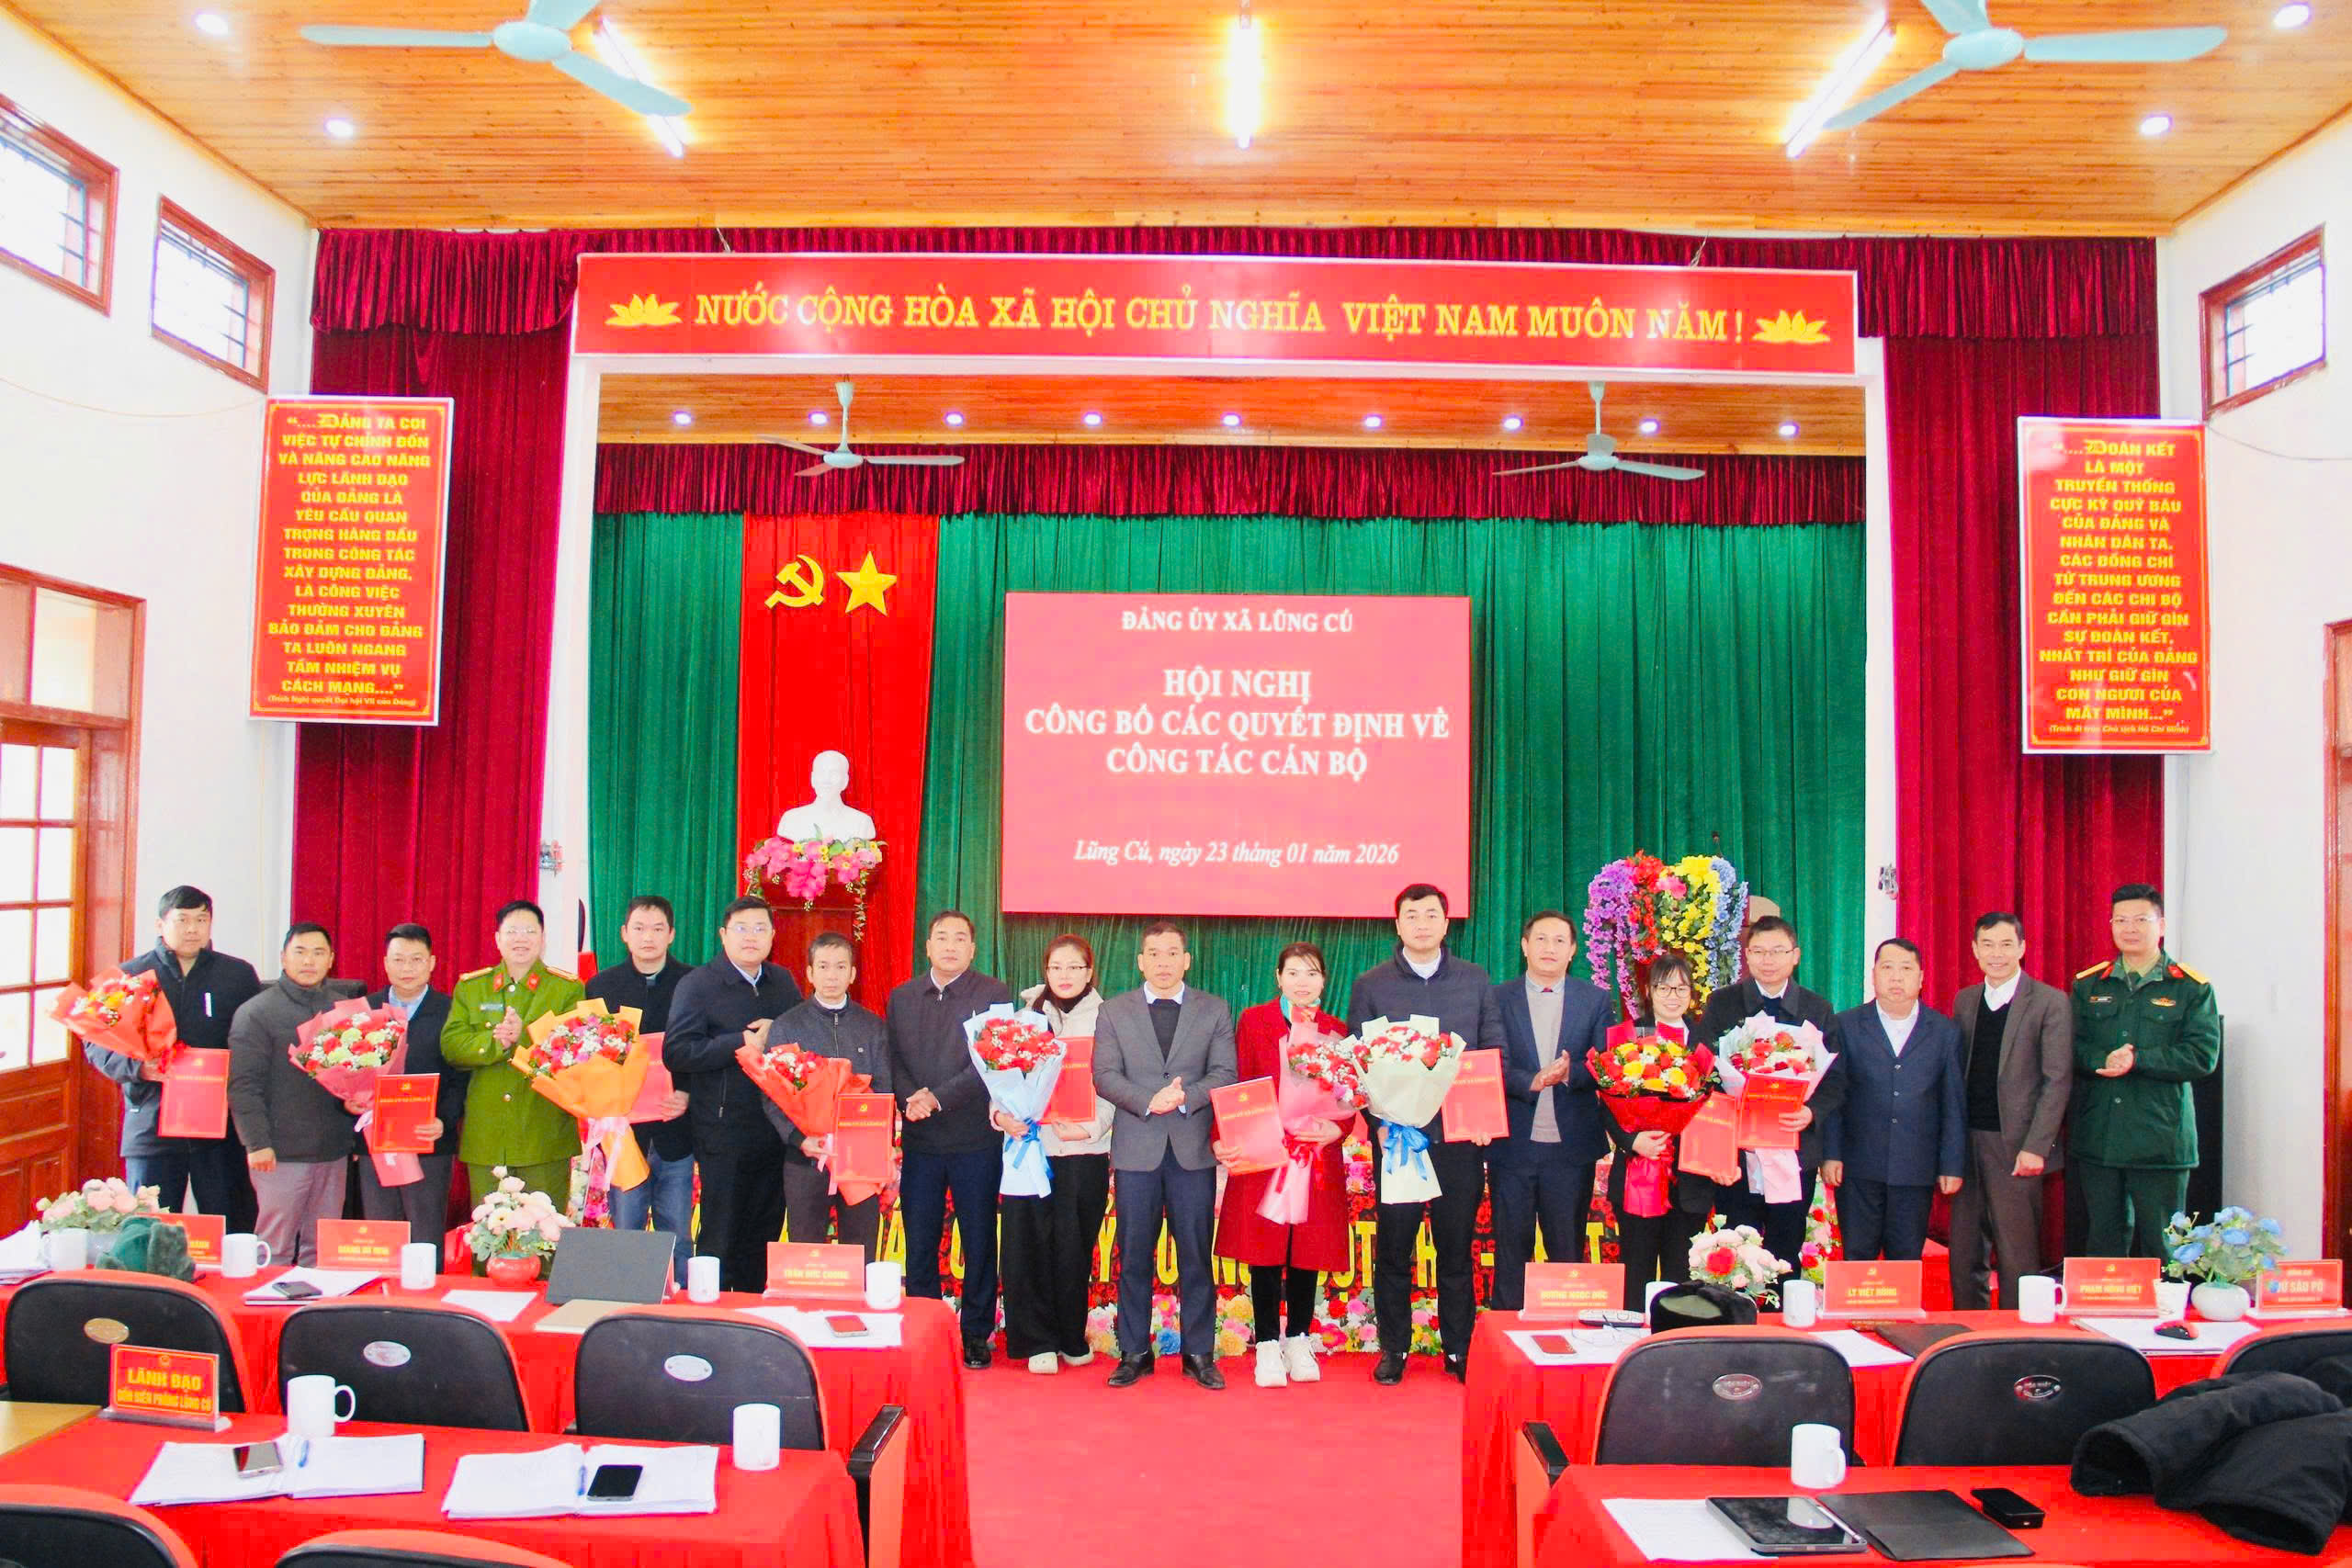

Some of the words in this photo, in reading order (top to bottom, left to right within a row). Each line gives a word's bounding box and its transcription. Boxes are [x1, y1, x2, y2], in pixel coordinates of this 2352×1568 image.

[695, 283, 787, 325] NƯỚC
[797, 287, 893, 333] CỘNG
[903, 286, 978, 327] HÒA
[989, 288, 1040, 328] XÃ
[1051, 288, 1115, 336] HỘI
[1126, 286, 1196, 329] CHỦ
[1209, 291, 1324, 333] NGHĨA
[1342, 296, 1425, 341] VIỆT
[1435, 304, 1518, 337] NAM
[1528, 299, 1634, 338] MUÔN
[377, 414, 395, 430] TA
[400, 417, 425, 430] COI
[282, 433, 317, 448] VIỆC
[321, 434, 343, 449] TỰ
[2146, 441, 2176, 456] KẾT
[279, 451, 299, 465] VÀ
[302, 452, 346, 466] NÂNG
[350, 451, 382, 466] CAO
[2086, 459, 2105, 473] LÀ
[2109, 460, 2143, 476] MỘT
[298, 472, 327, 488] LỰC
[332, 471, 372, 485] LÃNH
[377, 474, 408, 488] ĐẠO
[2055, 478, 2118, 492] TRUYỀN
[2122, 478, 2175, 494] THỐNG
[301, 487, 332, 502] CỦA
[336, 488, 379, 503] ĐẢNG
[384, 487, 402, 504] LÀ
[2050, 497, 2082, 513] CỰC
[2087, 497, 2109, 511] KỲ
[2149, 499, 2181, 513] BÁU
[296, 507, 324, 522] YÊU
[329, 507, 359, 522] CẦU
[364, 511, 407, 524] QUAN
[2062, 513, 2095, 529] CỦA
[2099, 513, 2144, 530] ĐẢNG
[2149, 516, 2170, 531] VÀ
[284, 528, 334, 542] TRỌNG
[339, 527, 380, 541] HÀNG
[386, 527, 417, 542] ĐẦU
[2060, 535, 2106, 548] NHÂN
[2110, 535, 2144, 552] DÂN
[283, 547, 334, 560] TRONG
[338, 547, 381, 560] CÔNG
[385, 547, 415, 561] TÁC
[2060, 553, 2093, 568] CÁC
[2098, 552, 2143, 568] ĐỒNG
[2146, 555, 2174, 569] CHÍ
[284, 564, 314, 579] XÂY
[318, 566, 361, 581] DỰNG
[2054, 570, 2076, 586] TỪ
[2078, 573, 2132, 586] TRUNG
[2137, 574, 2181, 588] ƯƠNG
[295, 583, 314, 598] LÀ
[318, 583, 361, 598] CÔNG
[365, 584, 400, 601] VIỆC
[2053, 590, 2086, 609] ĐẾN
[2091, 591, 2124, 609] CÁC
[2129, 593, 2156, 606] CHI
[2161, 592, 2182, 608] BỘ
[354, 604, 405, 618] XUYÊN
[1122, 606, 1182, 630] ĐẢNG
[1223, 608, 1252, 631] XÃ
[1259, 609, 1317, 632] LŨNG
[1324, 608, 1352, 632] CÚ
[2086, 608, 2124, 625] PHẢI
[2129, 611, 2158, 626] GIỮ
[2161, 612, 2188, 626] GÌN
[268, 620, 300, 635] BẢO
[304, 620, 339, 636] ĐẢM
[345, 625, 376, 637] CHO
[379, 621, 423, 637] ĐẢNG
[2064, 629, 2087, 645] SỰ
[2090, 628, 2135, 643] ĐOÀN
[282, 641, 302, 658] TA
[306, 640, 347, 654] LUÔN
[352, 643, 406, 656] NGANG
[2039, 647, 2083, 662] NHẤT
[2086, 647, 2112, 662] TRÍ
[2117, 647, 2150, 663] CỦA
[2154, 647, 2198, 664] ĐẢNG
[324, 661, 376, 676] NHIỆM
[380, 662, 401, 678] VỤ
[2070, 669, 2104, 683] NHƯ
[2109, 667, 2138, 682] GIỮ
[2141, 668, 2169, 682] GÌN
[281, 679, 323, 697] CÁCH
[1163, 665, 1222, 705] HỘI
[1231, 670, 1311, 706] NGHỊ
[2056, 687, 2090, 703] CON
[2149, 684, 2182, 702] CỦA
[1025, 703, 1106, 734] CÔNG
[1114, 704, 1153, 735] BỐ
[1161, 704, 1220, 735] CÁC
[1226, 705, 1326, 743] QUYẾT
[1332, 713, 1404, 743] ĐỊNH
[1411, 706, 1450, 738] VỀ
[1107, 742, 1188, 773] CÔNG
[1195, 742, 1253, 774] TÁC
[1261, 744, 1320, 774] CÁN
[1328, 748, 1367, 782] BỘ
[1074, 840, 1120, 865] Lũng
[1125, 840, 1153, 863] Cú,
[1159, 841, 1202, 866] ngày
[1205, 841, 1227, 862] 23
[1232, 841, 1283, 867] tháng
[1287, 843, 1307, 863] 01
[1313, 845, 1351, 863] năm
[1354, 843, 1399, 864] 2026
